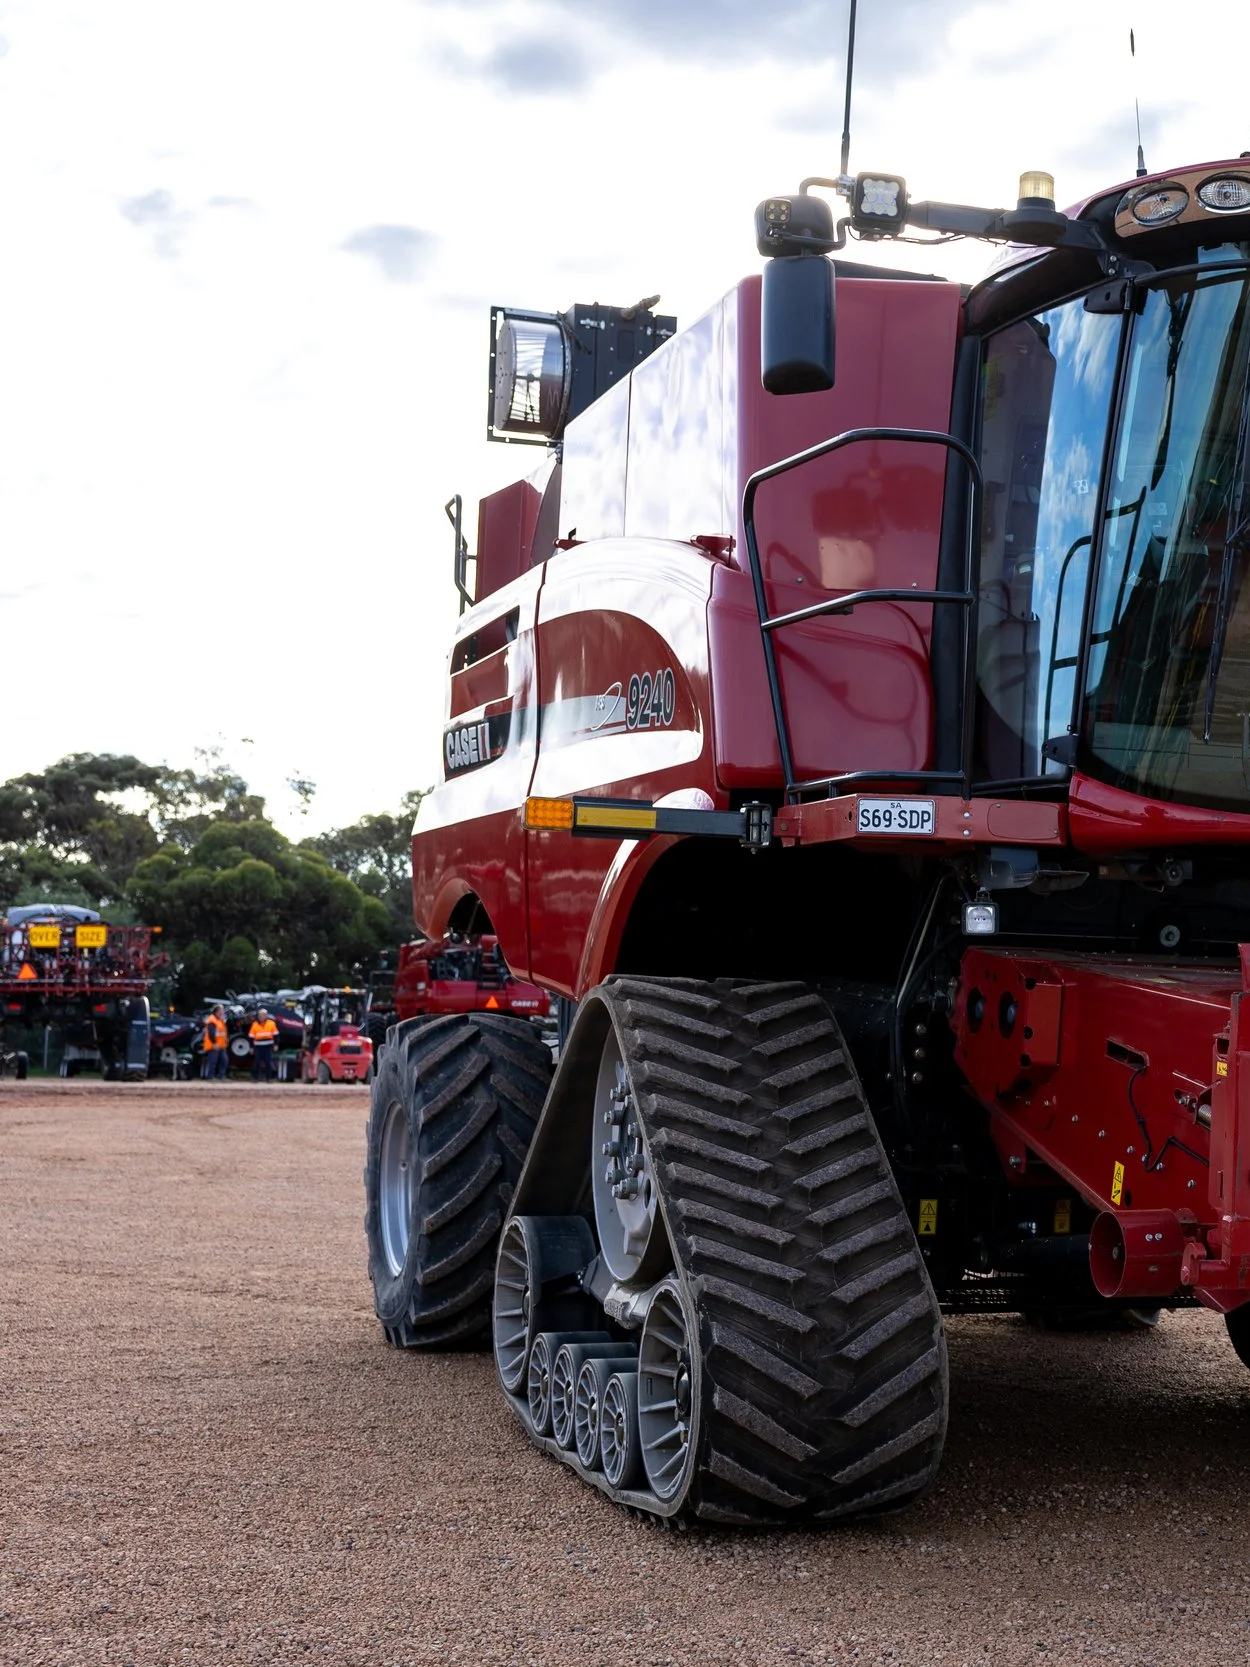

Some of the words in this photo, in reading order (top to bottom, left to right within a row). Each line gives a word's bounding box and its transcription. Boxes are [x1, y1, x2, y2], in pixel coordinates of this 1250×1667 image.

[626, 667, 675, 730] 9240
[445, 726, 479, 769] CASE
[31, 931, 59, 942] OVER
[79, 931, 102, 942] SIZE
